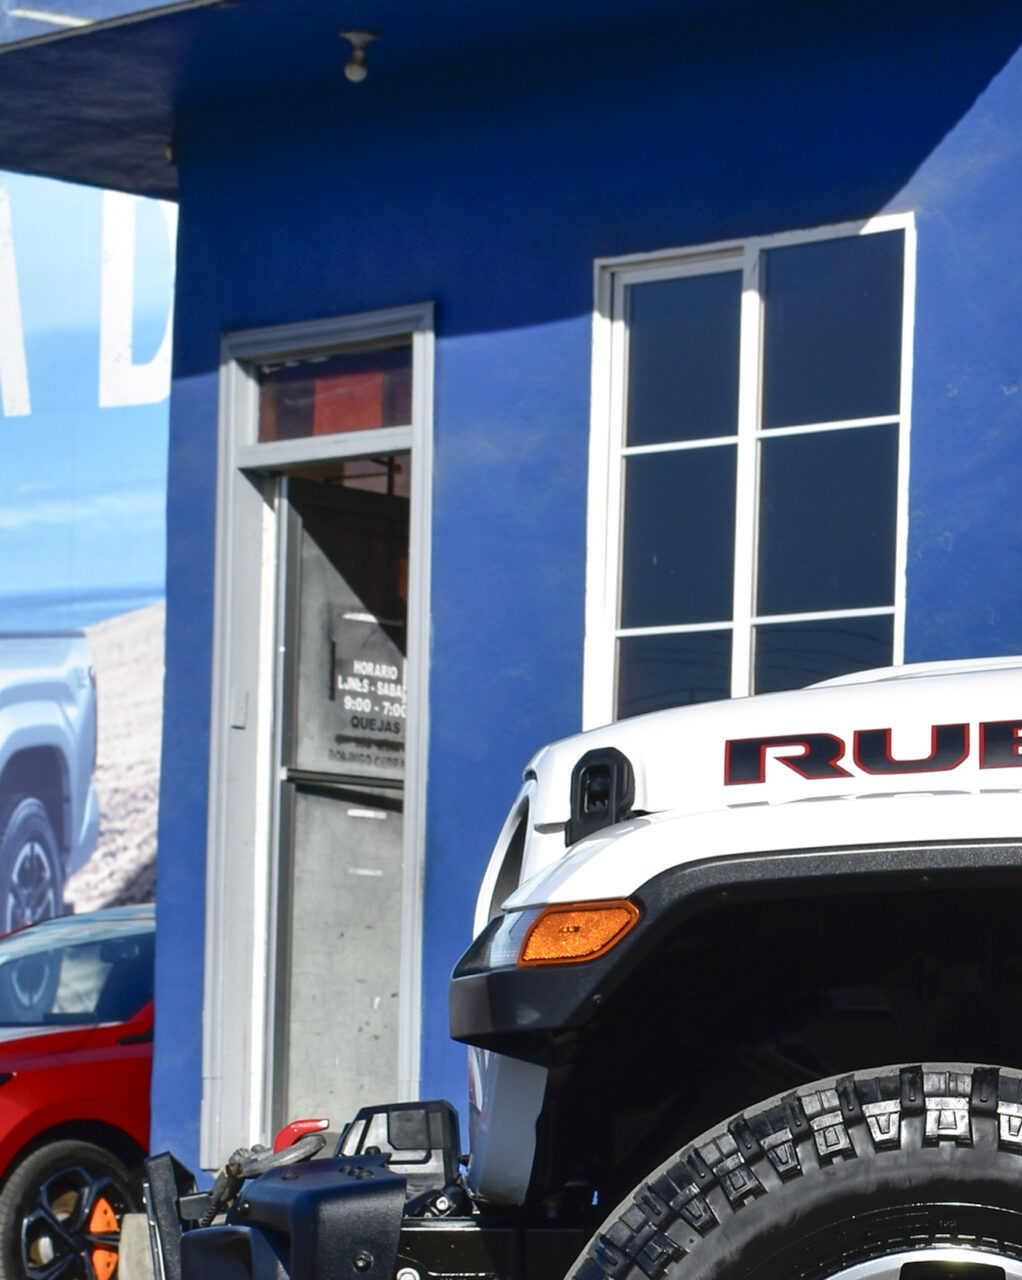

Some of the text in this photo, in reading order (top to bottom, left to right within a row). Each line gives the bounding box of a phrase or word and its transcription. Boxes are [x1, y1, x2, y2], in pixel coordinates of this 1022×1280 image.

[353, 660, 398, 680] HORARIO
[343, 695, 372, 712] 9:00
[350, 715, 401, 734] QUEJAS
